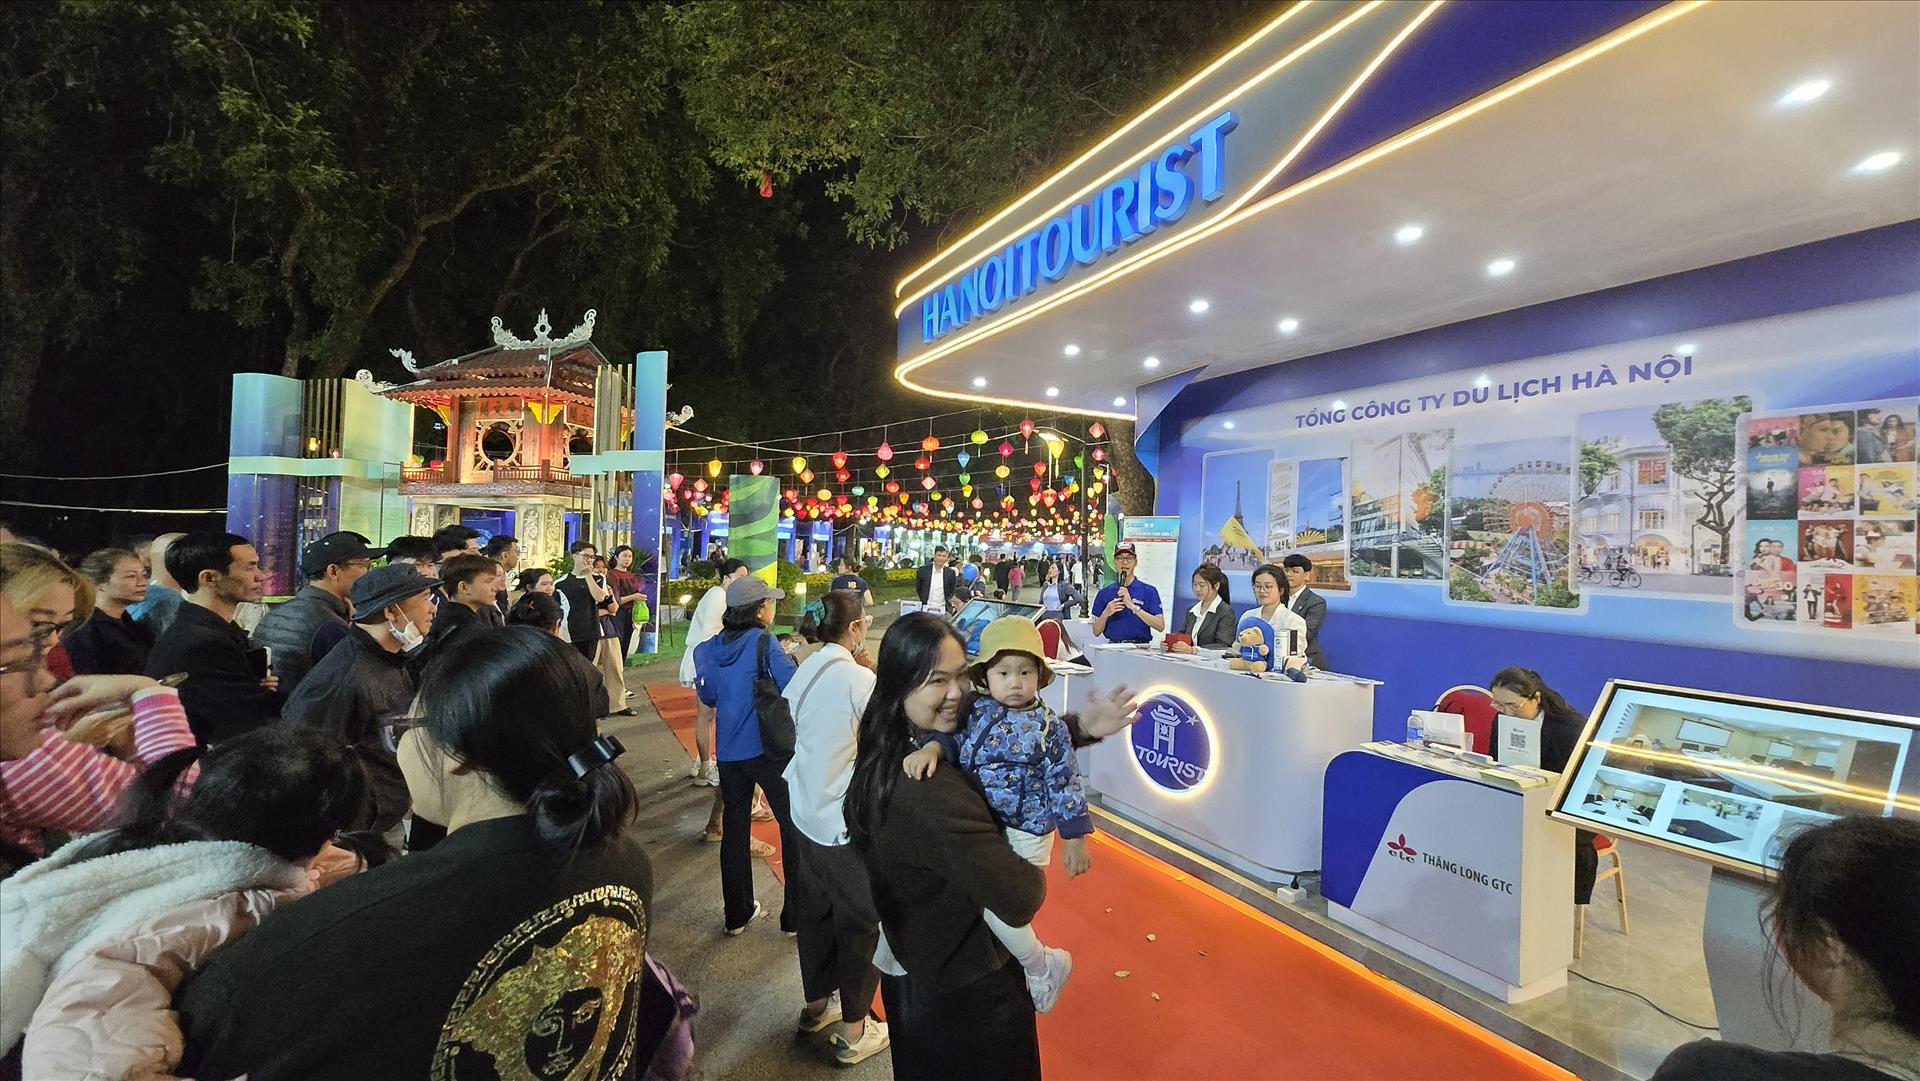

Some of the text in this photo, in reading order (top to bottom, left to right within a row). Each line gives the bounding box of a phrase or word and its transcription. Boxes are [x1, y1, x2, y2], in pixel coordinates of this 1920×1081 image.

[921, 111, 1239, 343] HANOITOURIST
[1295, 353, 1693, 428] TỔNG CÔNG TY DU LỊCH HÀ NỘI
[1135, 744, 1206, 782] TOURIST
[1460, 866, 1489, 886] LONG
[1491, 878, 1513, 895] GTC
